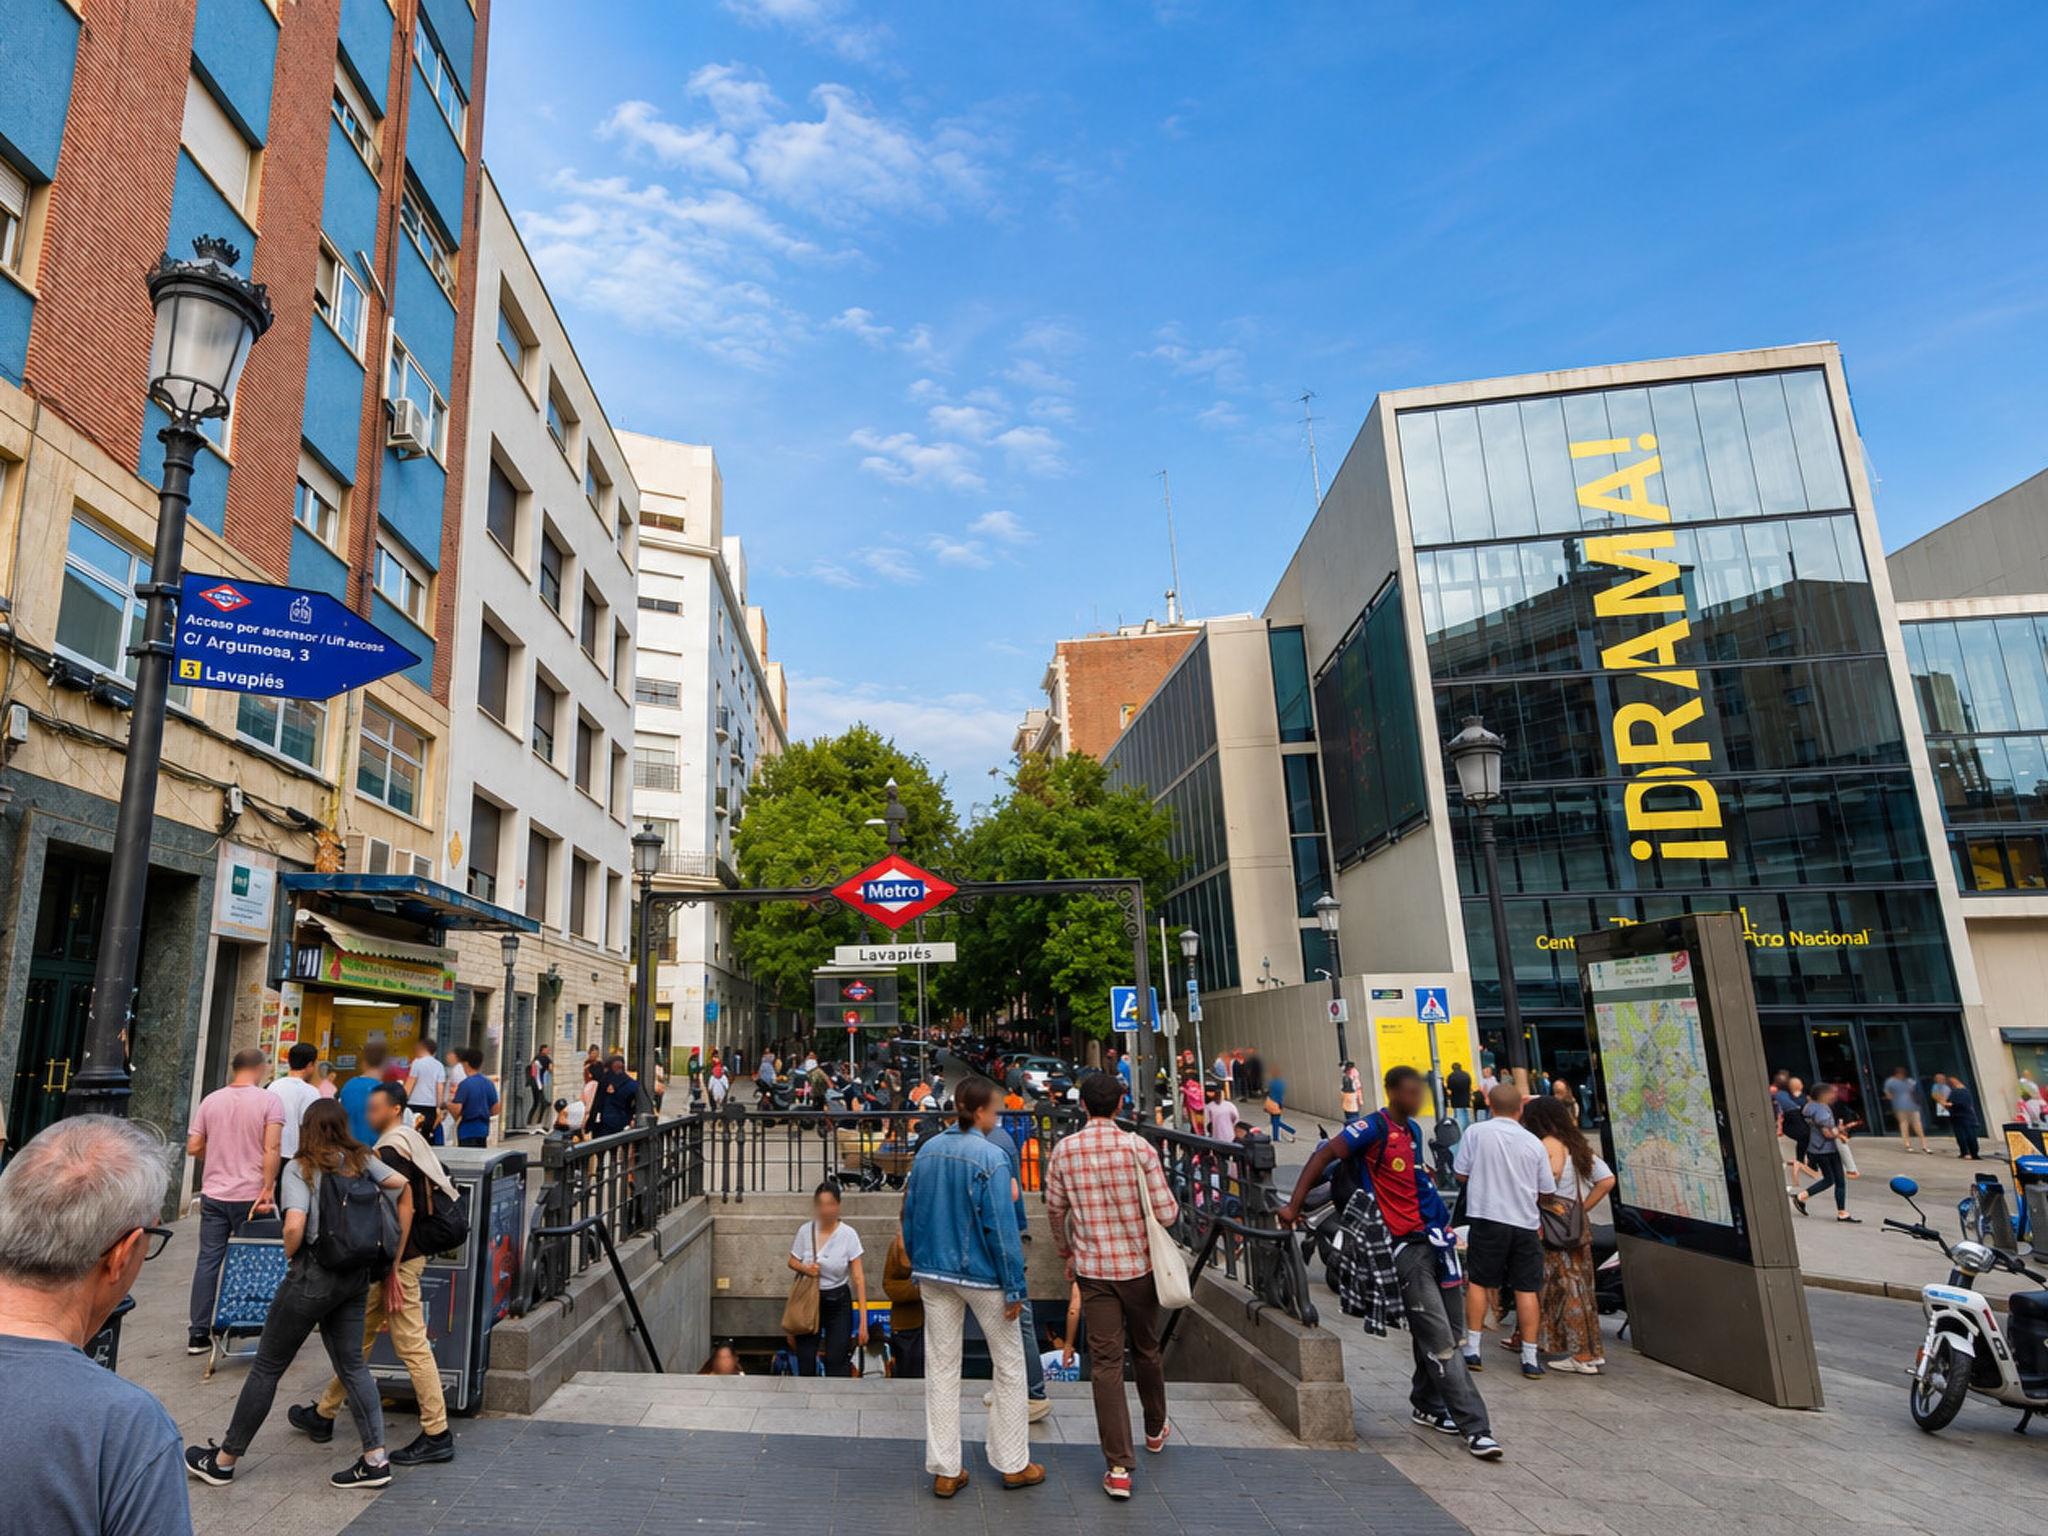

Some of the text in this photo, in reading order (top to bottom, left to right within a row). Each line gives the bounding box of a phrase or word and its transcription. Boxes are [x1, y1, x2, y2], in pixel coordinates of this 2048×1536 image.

[237, 623, 260, 635] por
[183, 631, 202, 646] C/
[299, 648, 310, 662] 3
[184, 662, 196, 677] 3
[206, 666, 285, 690] Lavapiés
[868, 884, 920, 899] Metro
[1536, 935, 1576, 950] Cent
[1789, 928, 1870, 946] Nacional
[859, 947, 932, 962] Lavapiés
